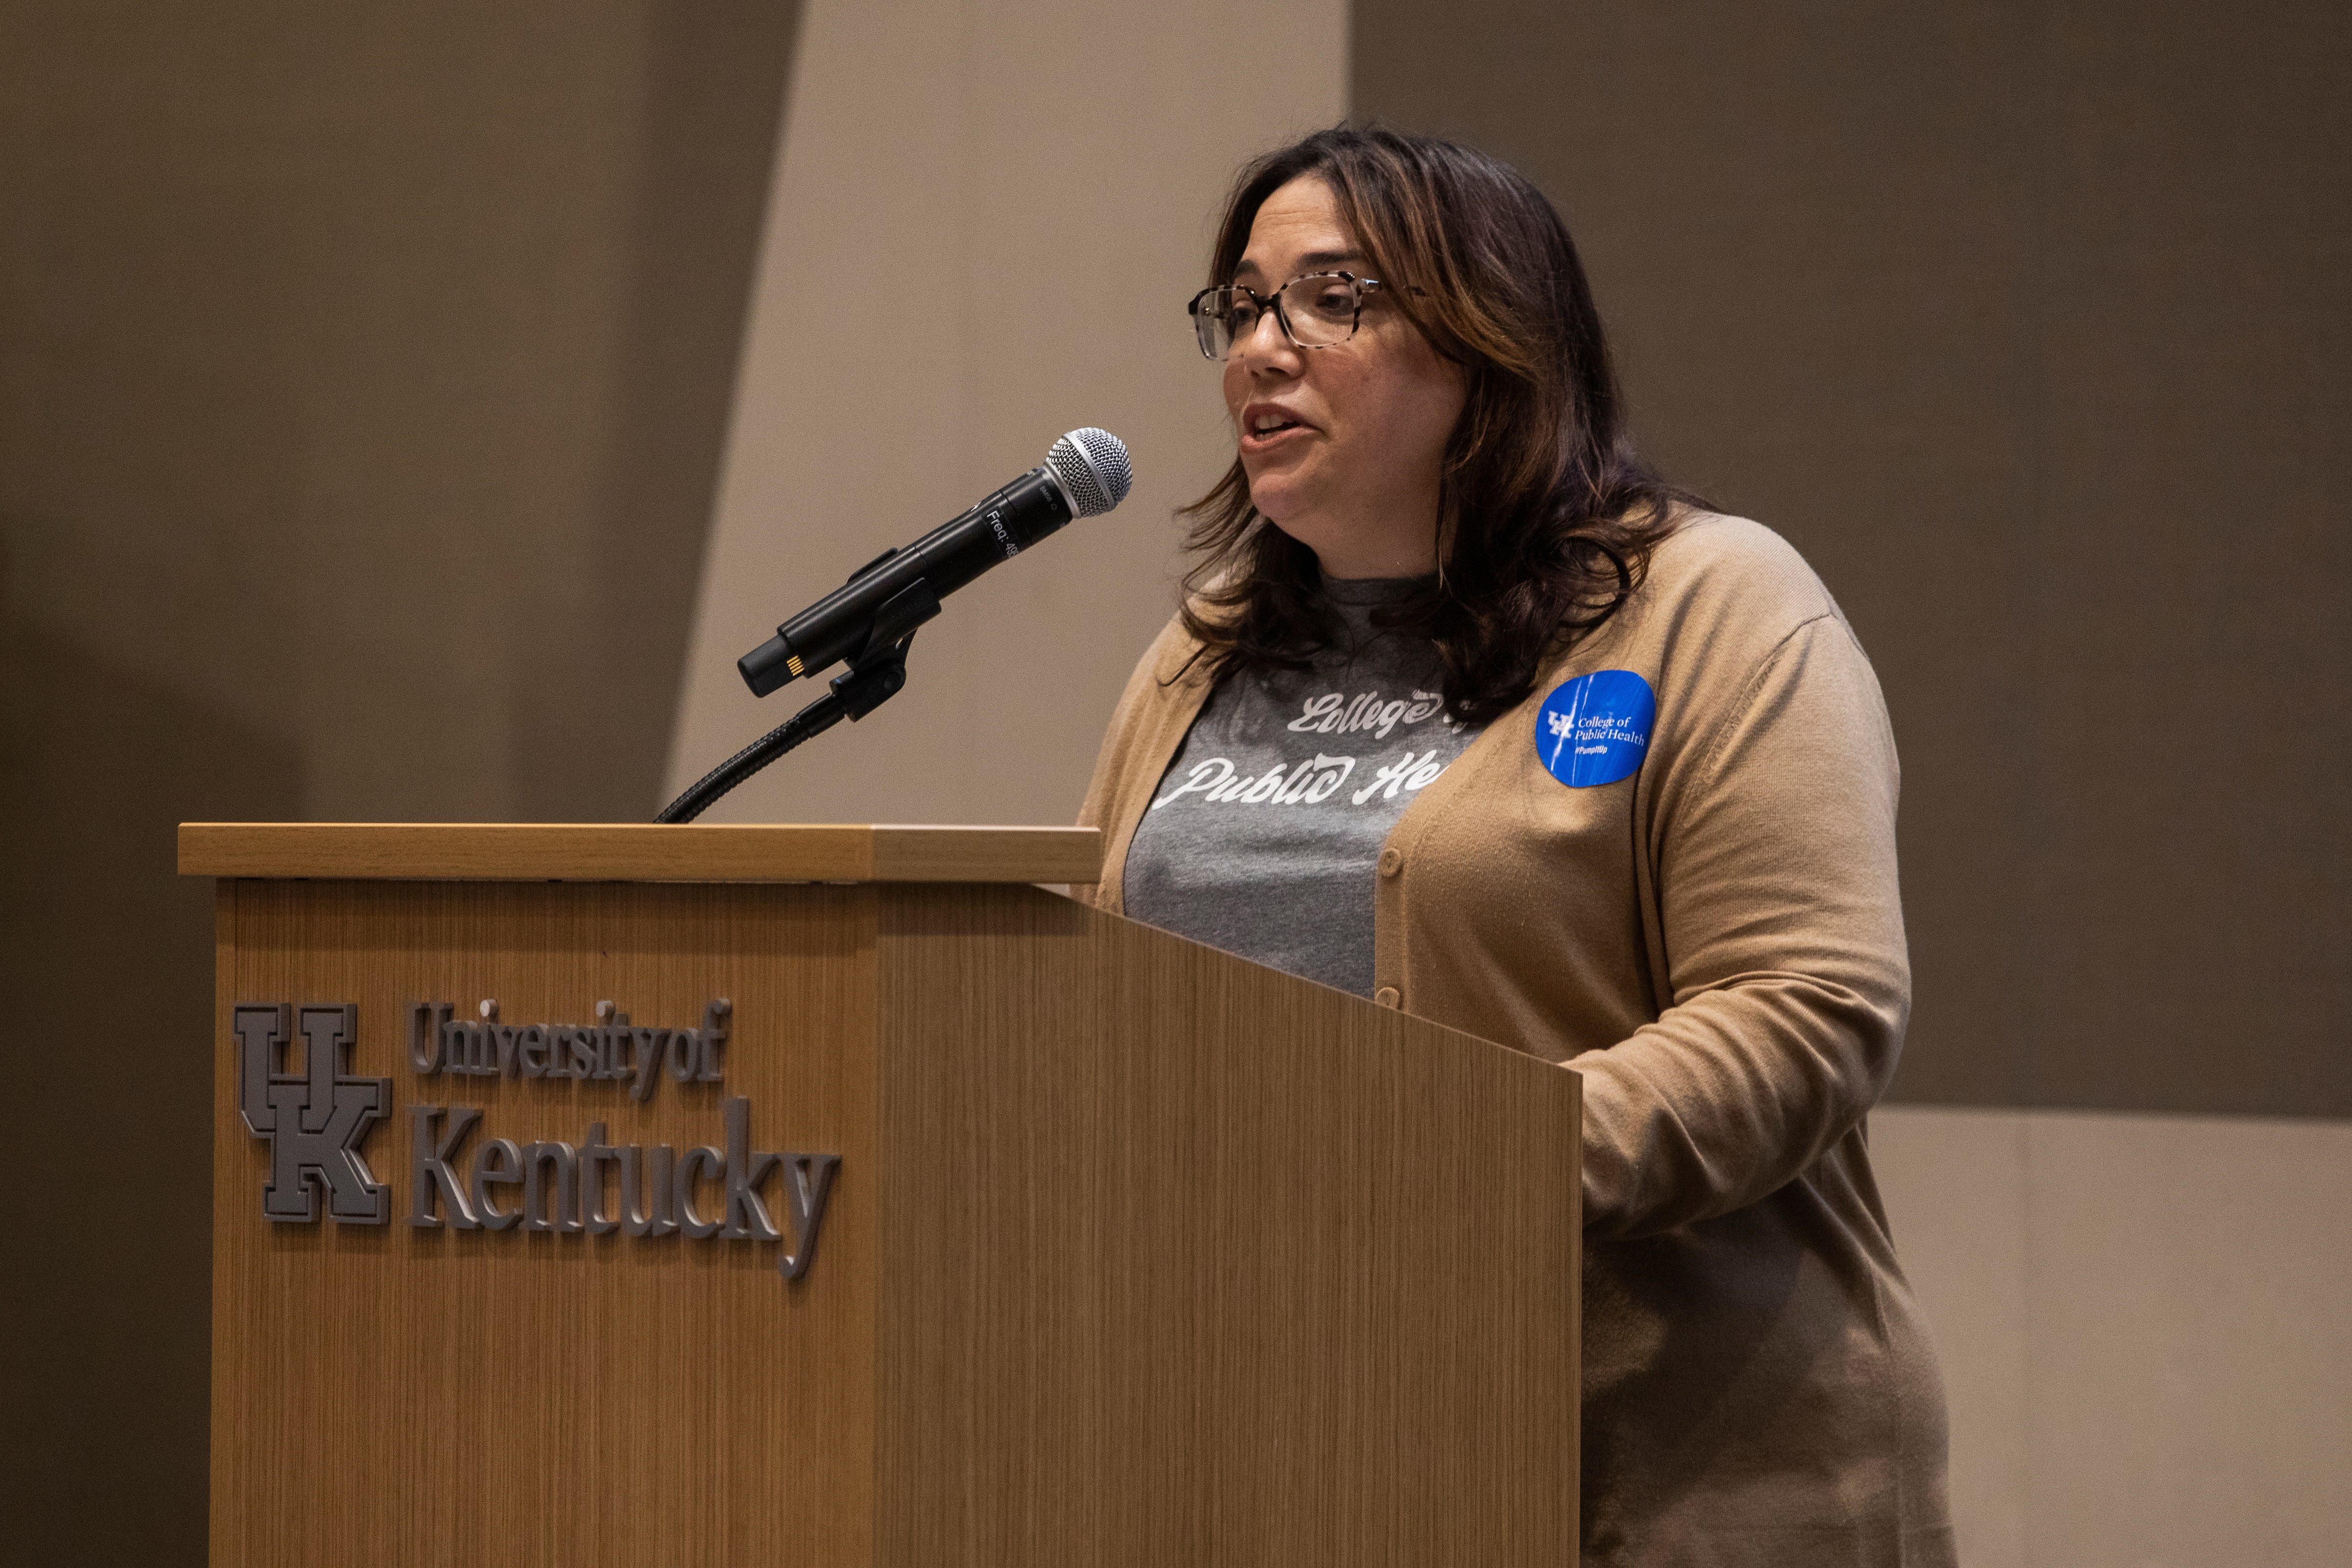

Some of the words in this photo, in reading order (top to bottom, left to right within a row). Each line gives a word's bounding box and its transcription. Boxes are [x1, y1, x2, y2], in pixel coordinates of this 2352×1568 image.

[987, 510, 1008, 542] Freq:
[1287, 689, 1444, 739] College
[1578, 716, 1615, 729] College
[1617, 716, 1631, 728] of
[1575, 729, 1606, 740] Public
[1608, 729, 1644, 747] Health
[1575, 745, 1608, 755] #PumpItUp
[1152, 753, 1355, 810] Public
[407, 999, 671, 1102] University
[665, 998, 733, 1083] of
[404, 1095, 842, 1278] Kentucky
